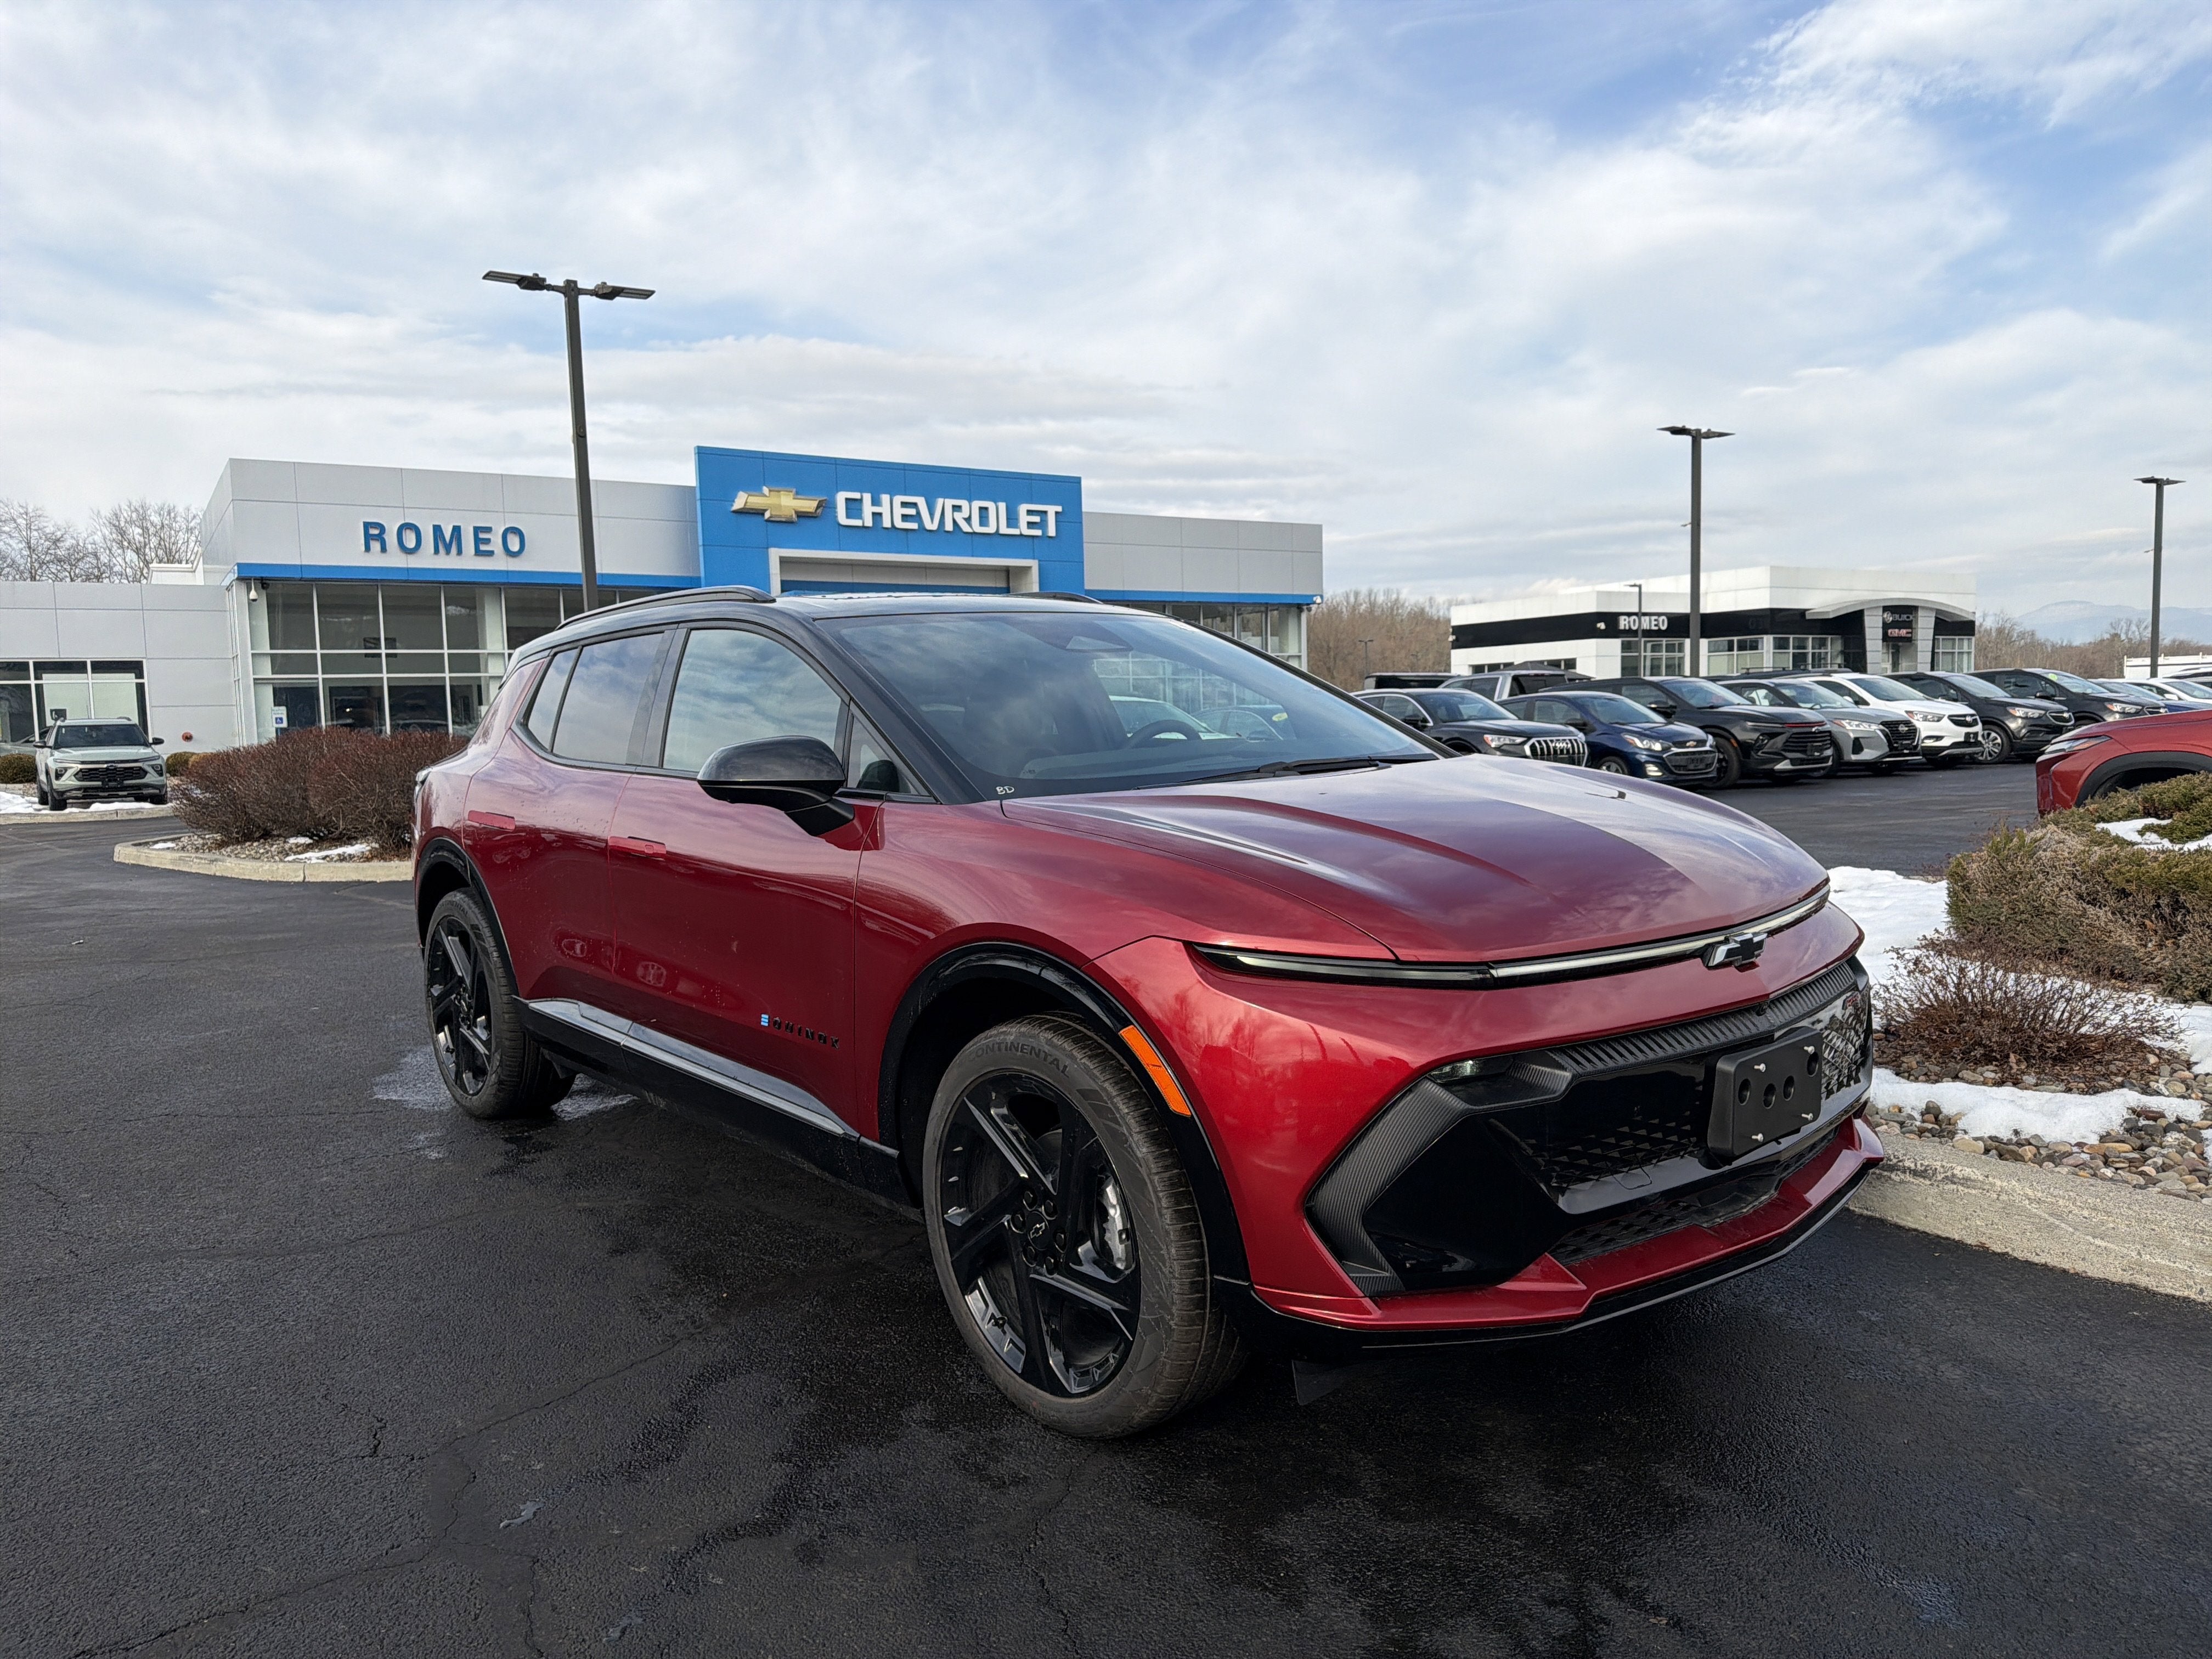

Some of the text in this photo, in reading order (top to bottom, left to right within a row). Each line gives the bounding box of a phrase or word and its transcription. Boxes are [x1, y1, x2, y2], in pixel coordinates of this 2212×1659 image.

[836, 491, 1063, 537] CHEVROLET
[363, 521, 526, 557] ROMEO
[1618, 615, 1668, 630] ROMEO
[1888, 628, 1912, 637] GMC
[760, 1014, 840, 1050] EQUINOX
